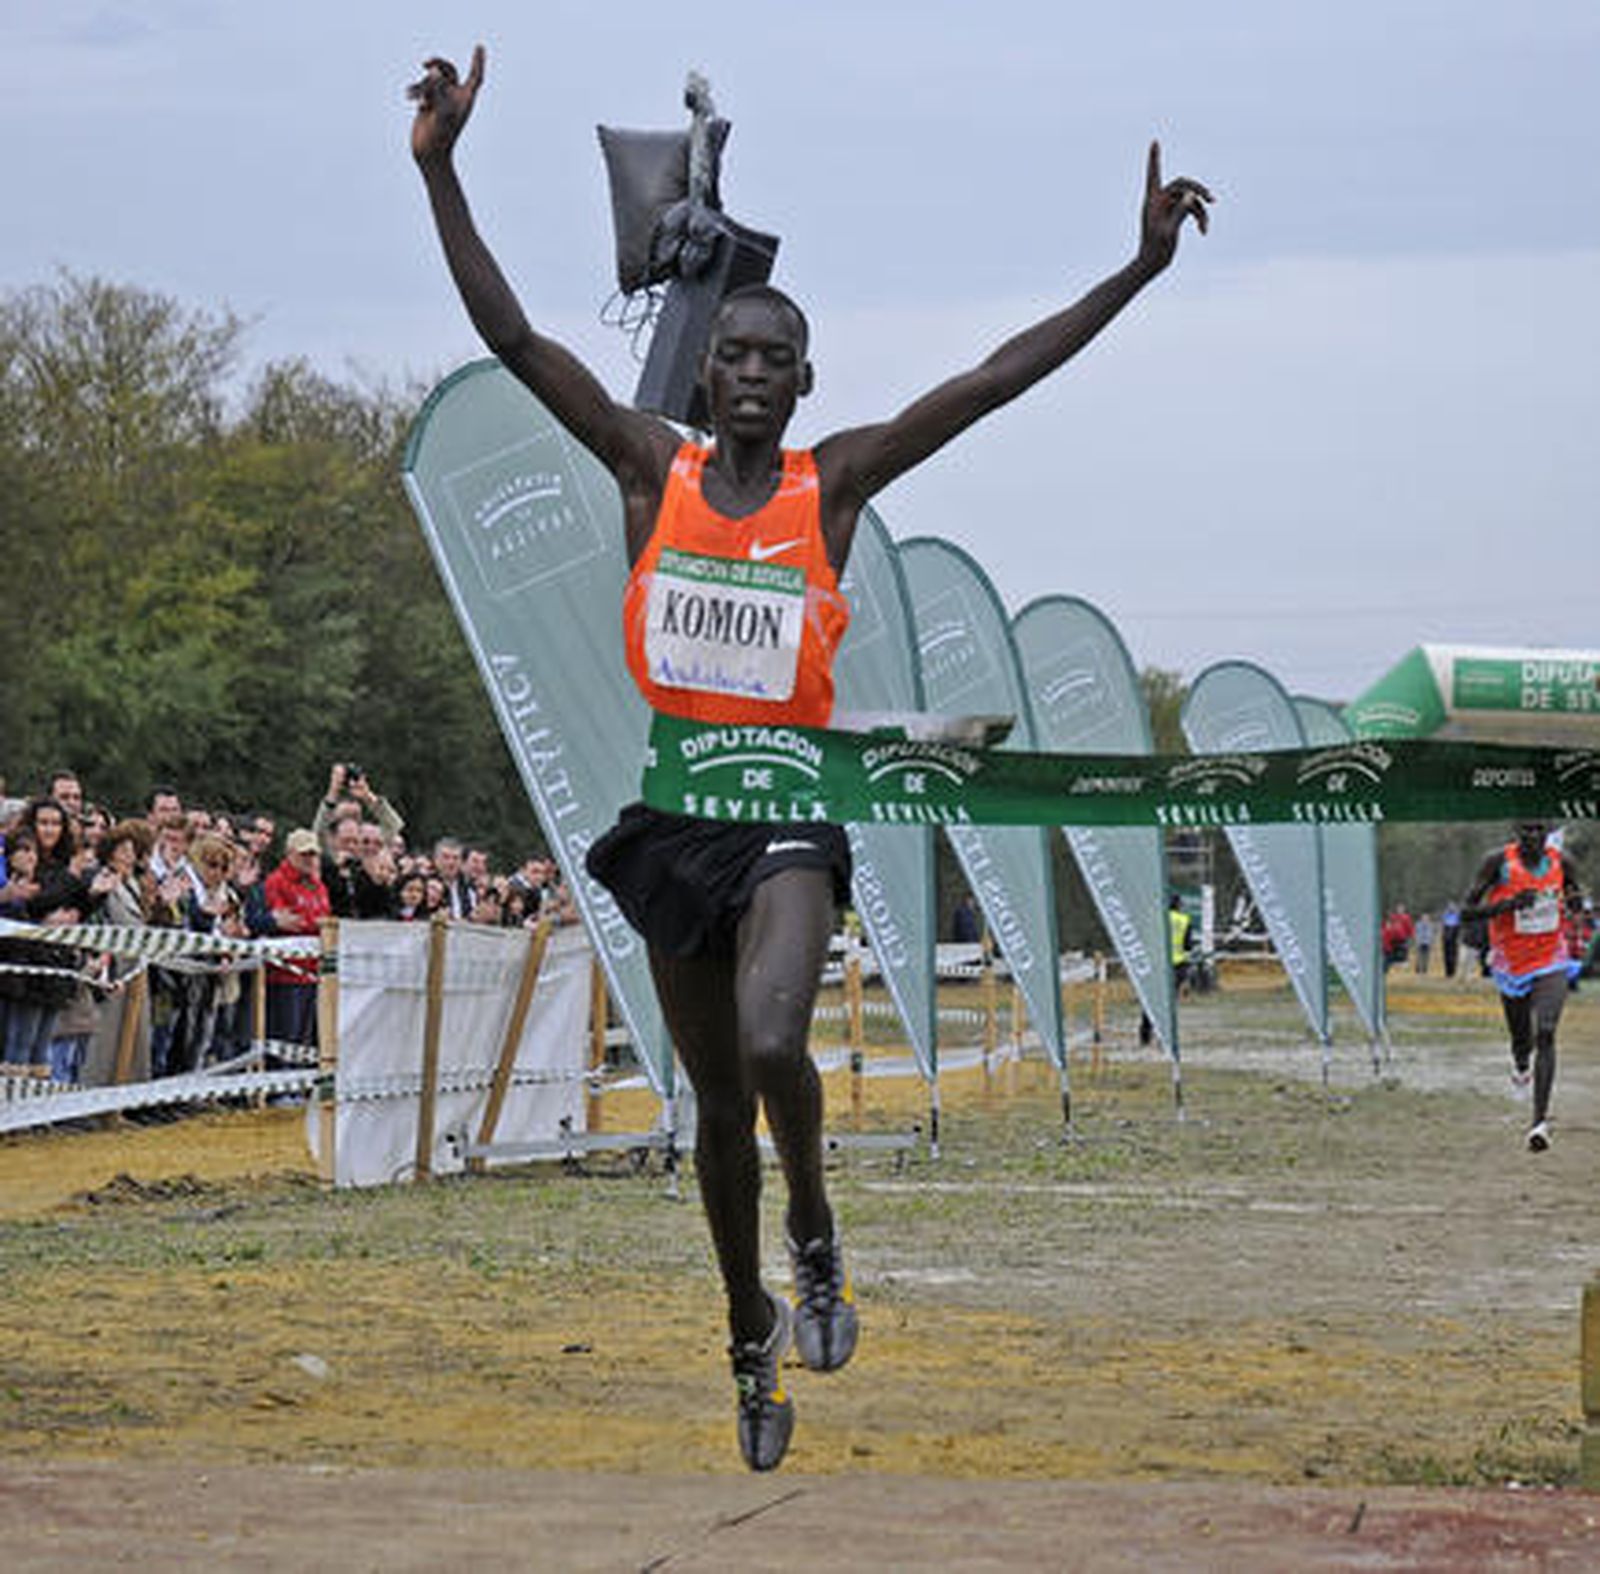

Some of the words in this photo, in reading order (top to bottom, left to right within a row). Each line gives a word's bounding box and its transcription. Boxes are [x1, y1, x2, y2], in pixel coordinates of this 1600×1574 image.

[662, 590, 784, 650] KOMON
[1521, 687, 1552, 709] DE
[743, 768, 773, 791] DE
[904, 772, 927, 794] DE
[683, 794, 829, 822] SEVILLA
[871, 802, 972, 823] SEVILLA
[1155, 803, 1251, 825] SEVILLA
[1292, 802, 1385, 821] SEVILLA
